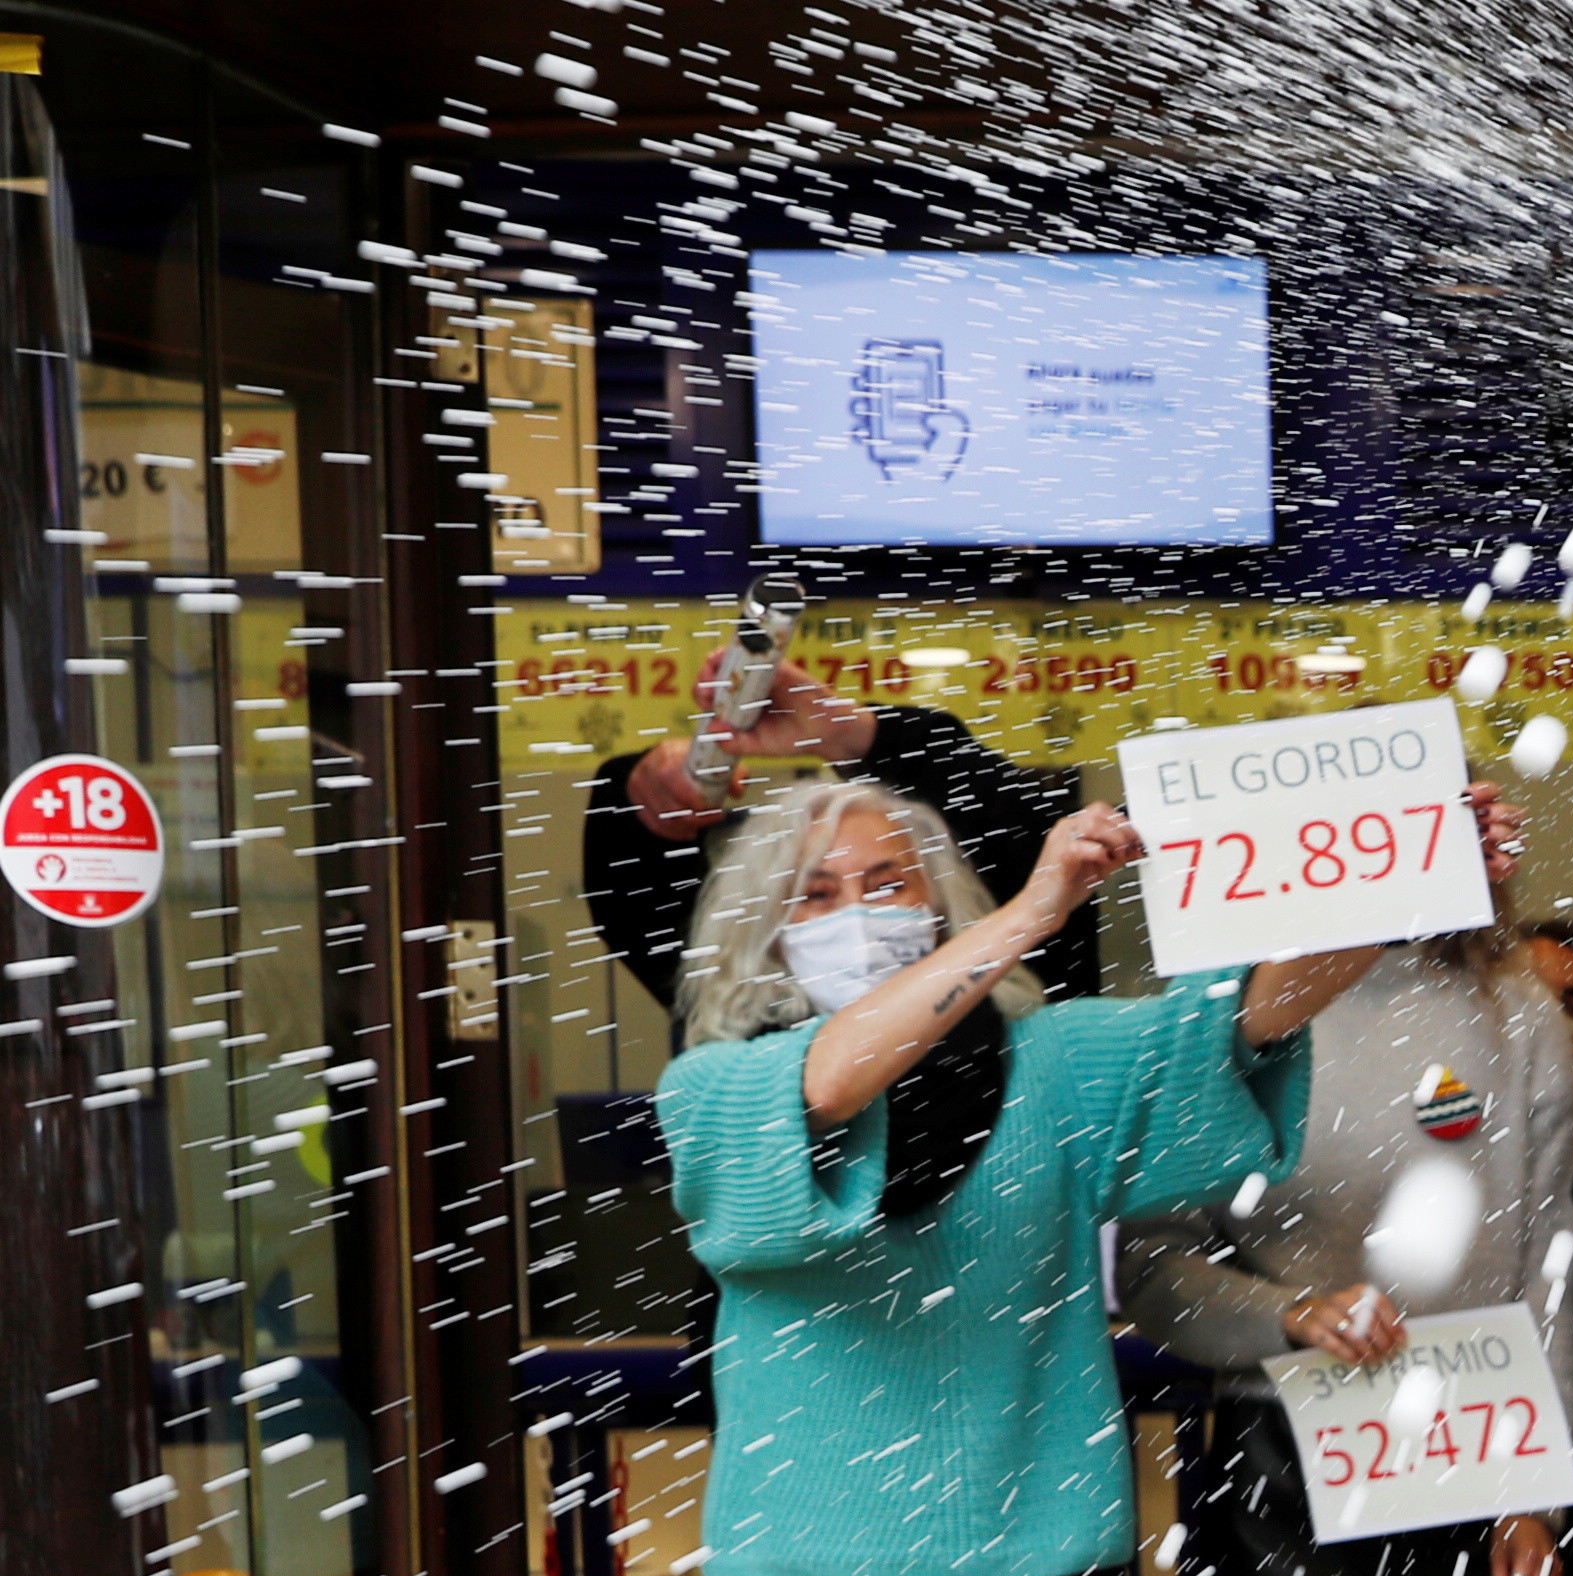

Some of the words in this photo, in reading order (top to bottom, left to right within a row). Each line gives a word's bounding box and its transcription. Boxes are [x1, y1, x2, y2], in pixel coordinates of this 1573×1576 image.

[32, 775, 127, 831] +18
[1157, 760, 1218, 805] EL
[1230, 729, 1427, 794] GORDO
[1159, 803, 1446, 910] 72.897
[1314, 1396, 1549, 1487] 52.472
